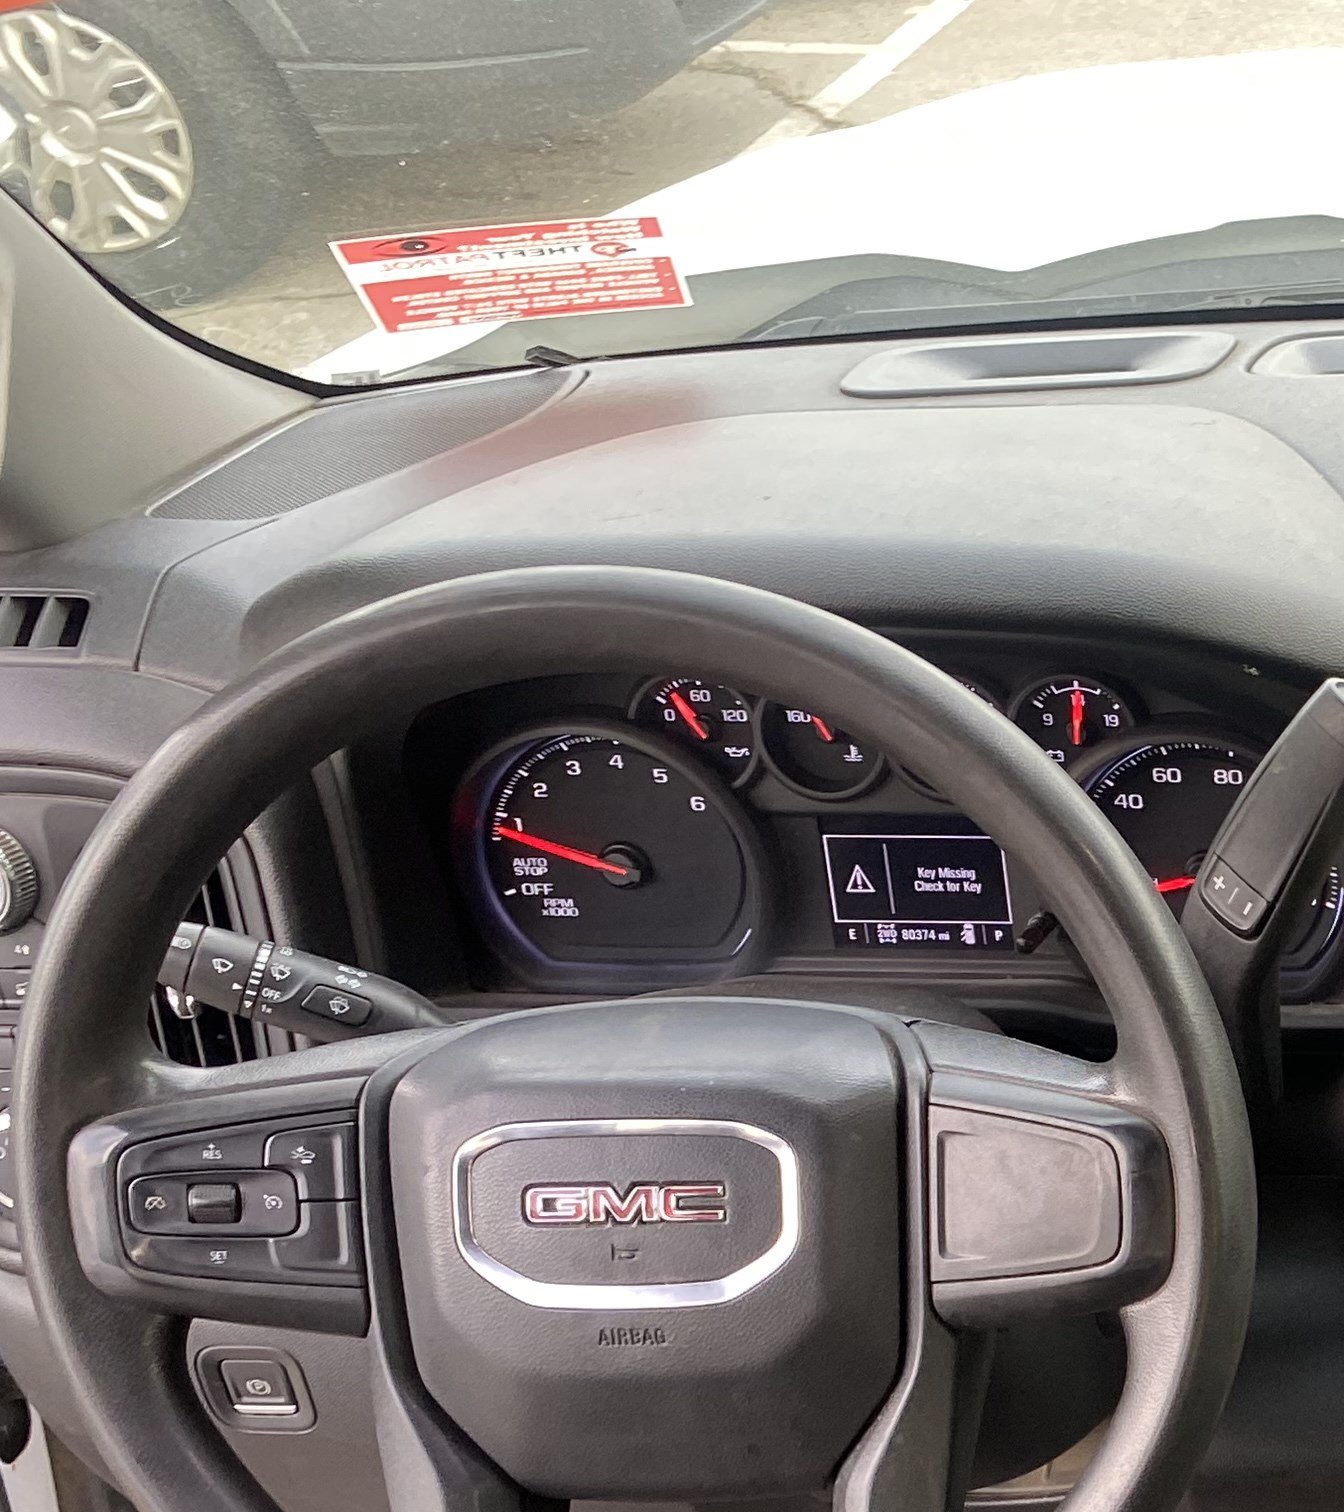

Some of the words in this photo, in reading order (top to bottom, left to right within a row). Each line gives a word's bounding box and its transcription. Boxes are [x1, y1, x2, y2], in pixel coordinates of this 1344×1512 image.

[689, 690, 712, 702] 60
[664, 709, 676, 722] 0
[721, 709, 748, 722] 120
[1042, 713, 1054, 726] 9
[1102, 714, 1120, 727] 19
[565, 760, 582, 776] 3
[609, 754, 625, 770] 4
[652, 768, 669, 784] 5
[1152, 767, 1182, 784] 60
[1213, 769, 1243, 785] 80
[532, 782, 549, 798] 2
[689, 796, 706, 812] 6
[1113, 793, 1144, 810] 40
[513, 817, 524, 832] 1
[512, 857, 548, 868] AUTO
[514, 866, 549, 877] STOP
[917, 867, 936, 881] Key
[938, 867, 976, 881] Missing
[520, 882, 554, 896] OFF
[914, 880, 945, 893] Check
[946, 881, 961, 892] for
[962, 881, 982, 895] Key
[542, 898, 574, 908] RPM
[541, 907, 580, 918] x1000
[848, 928, 858, 940] E
[901, 929, 937, 941] 80374
[938, 931, 951, 941] mi
[994, 929, 1004, 942] P
[260, 987, 283, 1001] OFF
[202, 1149, 223, 1160] RES
[523, 1184, 727, 1224] GMC
[209, 1250, 229, 1262] SET
[597, 1327, 668, 1347] AIRBAG
